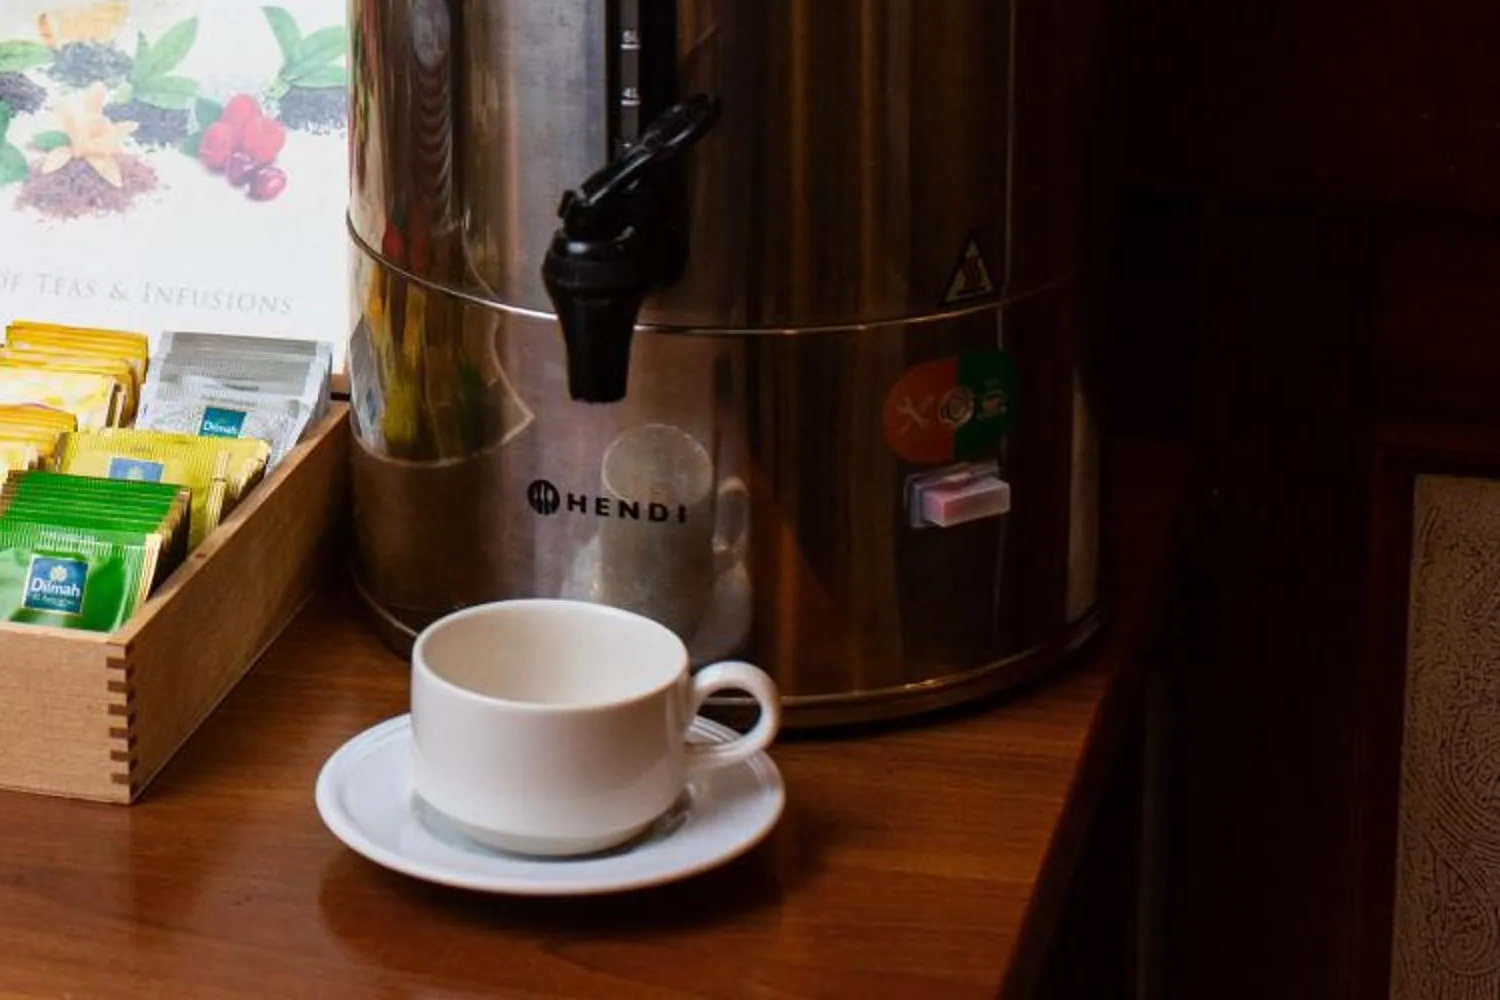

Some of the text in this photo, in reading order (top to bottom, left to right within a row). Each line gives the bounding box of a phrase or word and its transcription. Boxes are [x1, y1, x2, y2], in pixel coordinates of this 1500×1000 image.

[108, 282, 129, 301] &
[566, 492, 687, 524] HENDI
[30, 578, 81, 597] Dilmah
